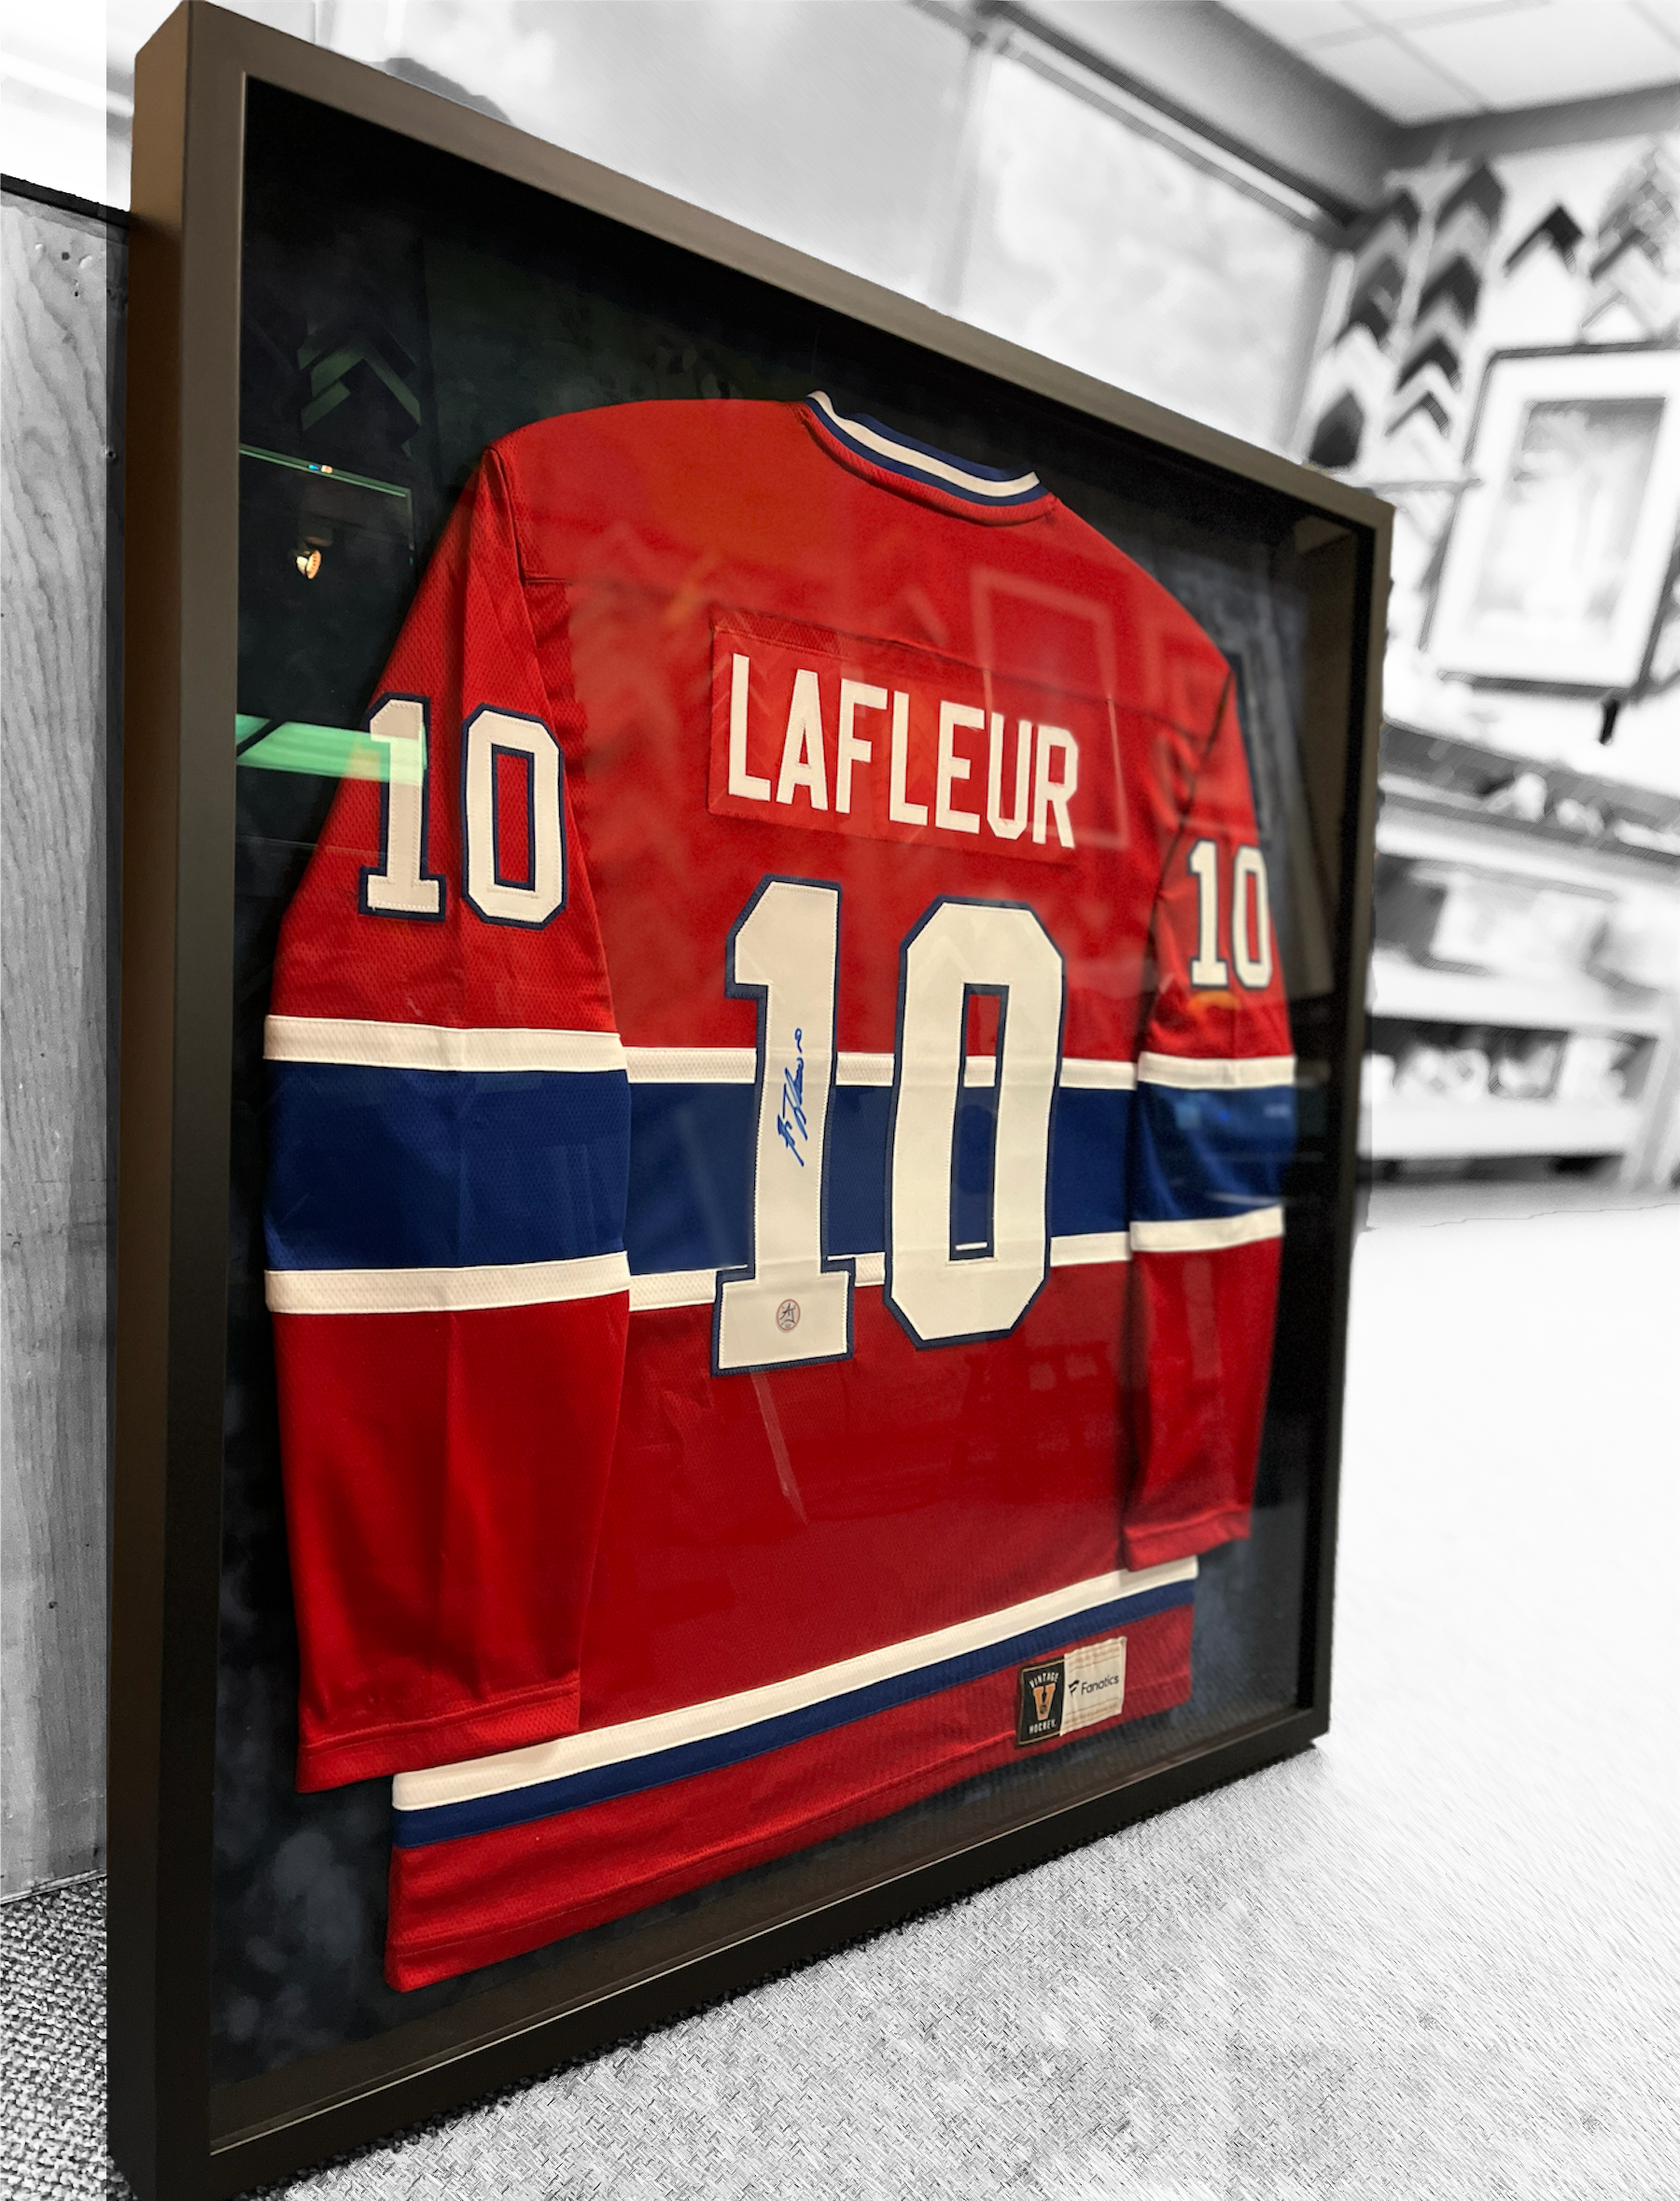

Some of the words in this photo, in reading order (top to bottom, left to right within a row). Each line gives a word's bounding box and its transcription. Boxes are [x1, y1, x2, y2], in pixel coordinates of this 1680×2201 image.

[357, 691, 567, 931] 10
[728, 652, 1079, 849] LAFLEUR
[1188, 838, 1273, 991] 10
[711, 874, 1066, 1377] 10
[1029, 1672, 1059, 1689] VINTAGE
[1080, 1675, 1120, 1696] Fanatics
